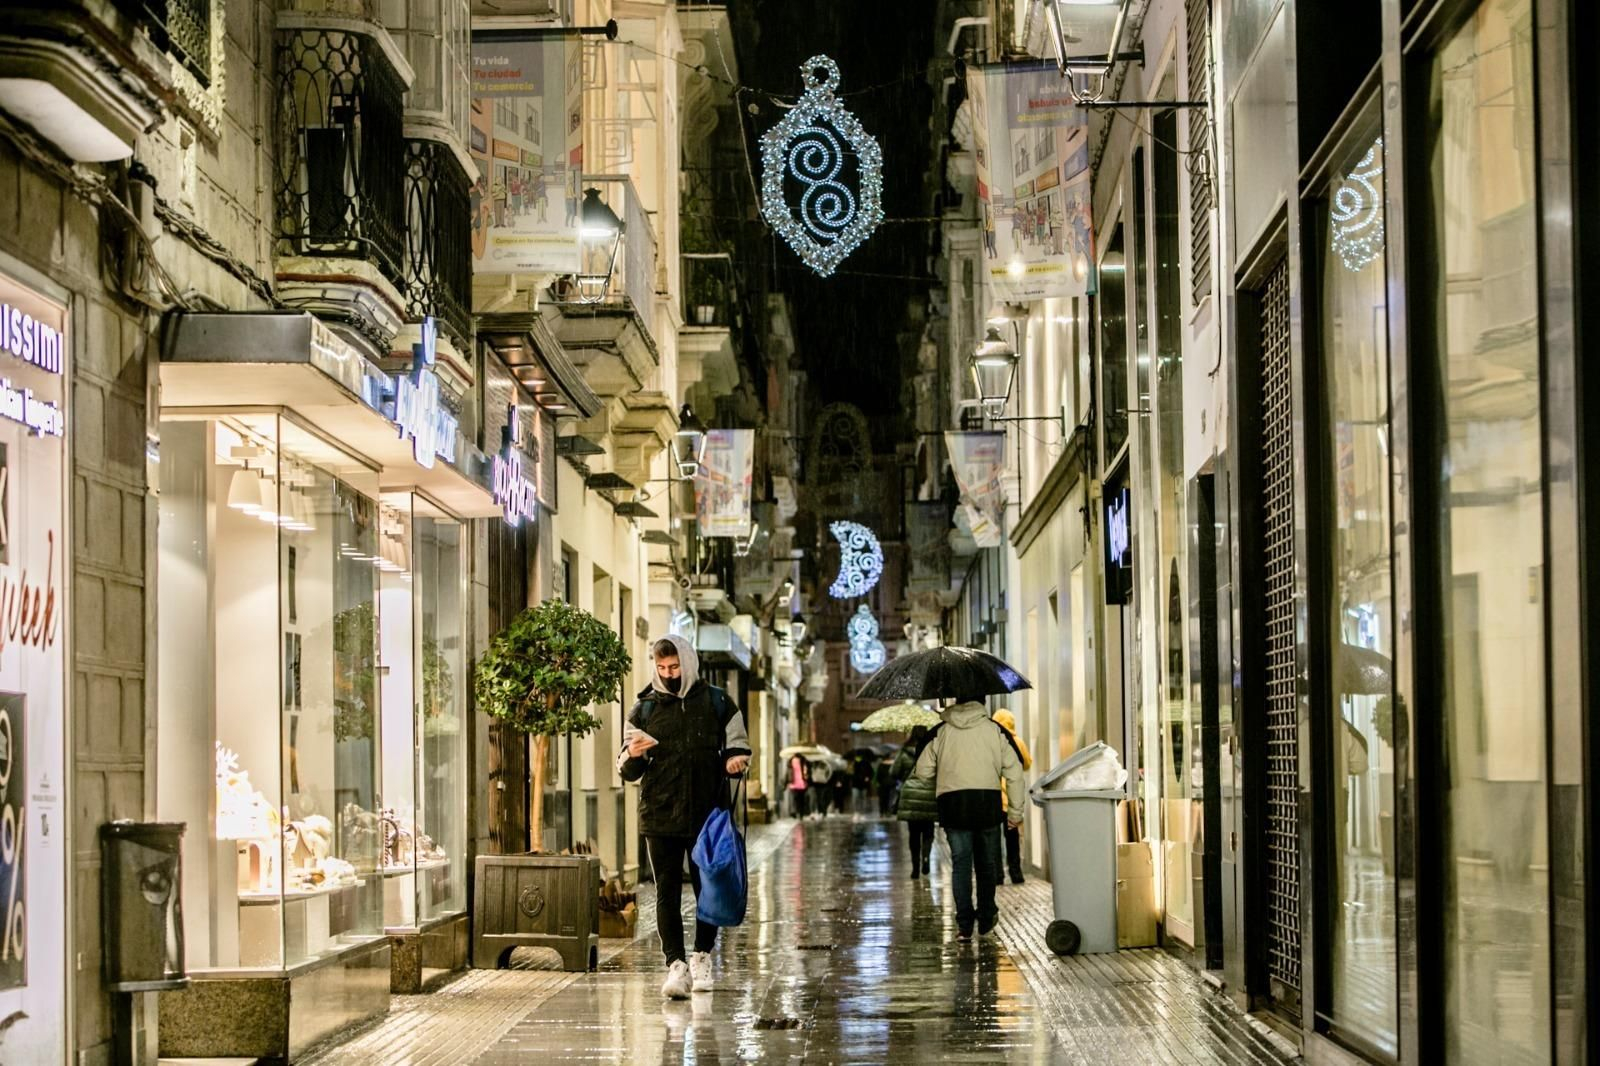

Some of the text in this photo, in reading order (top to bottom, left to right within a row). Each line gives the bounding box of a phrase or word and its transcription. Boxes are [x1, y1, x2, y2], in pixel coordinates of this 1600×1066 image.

[473, 56, 509, 65] Tu vida
[473, 69, 521, 78] Tu ciudad
[473, 82, 534, 91] Tu comercio
